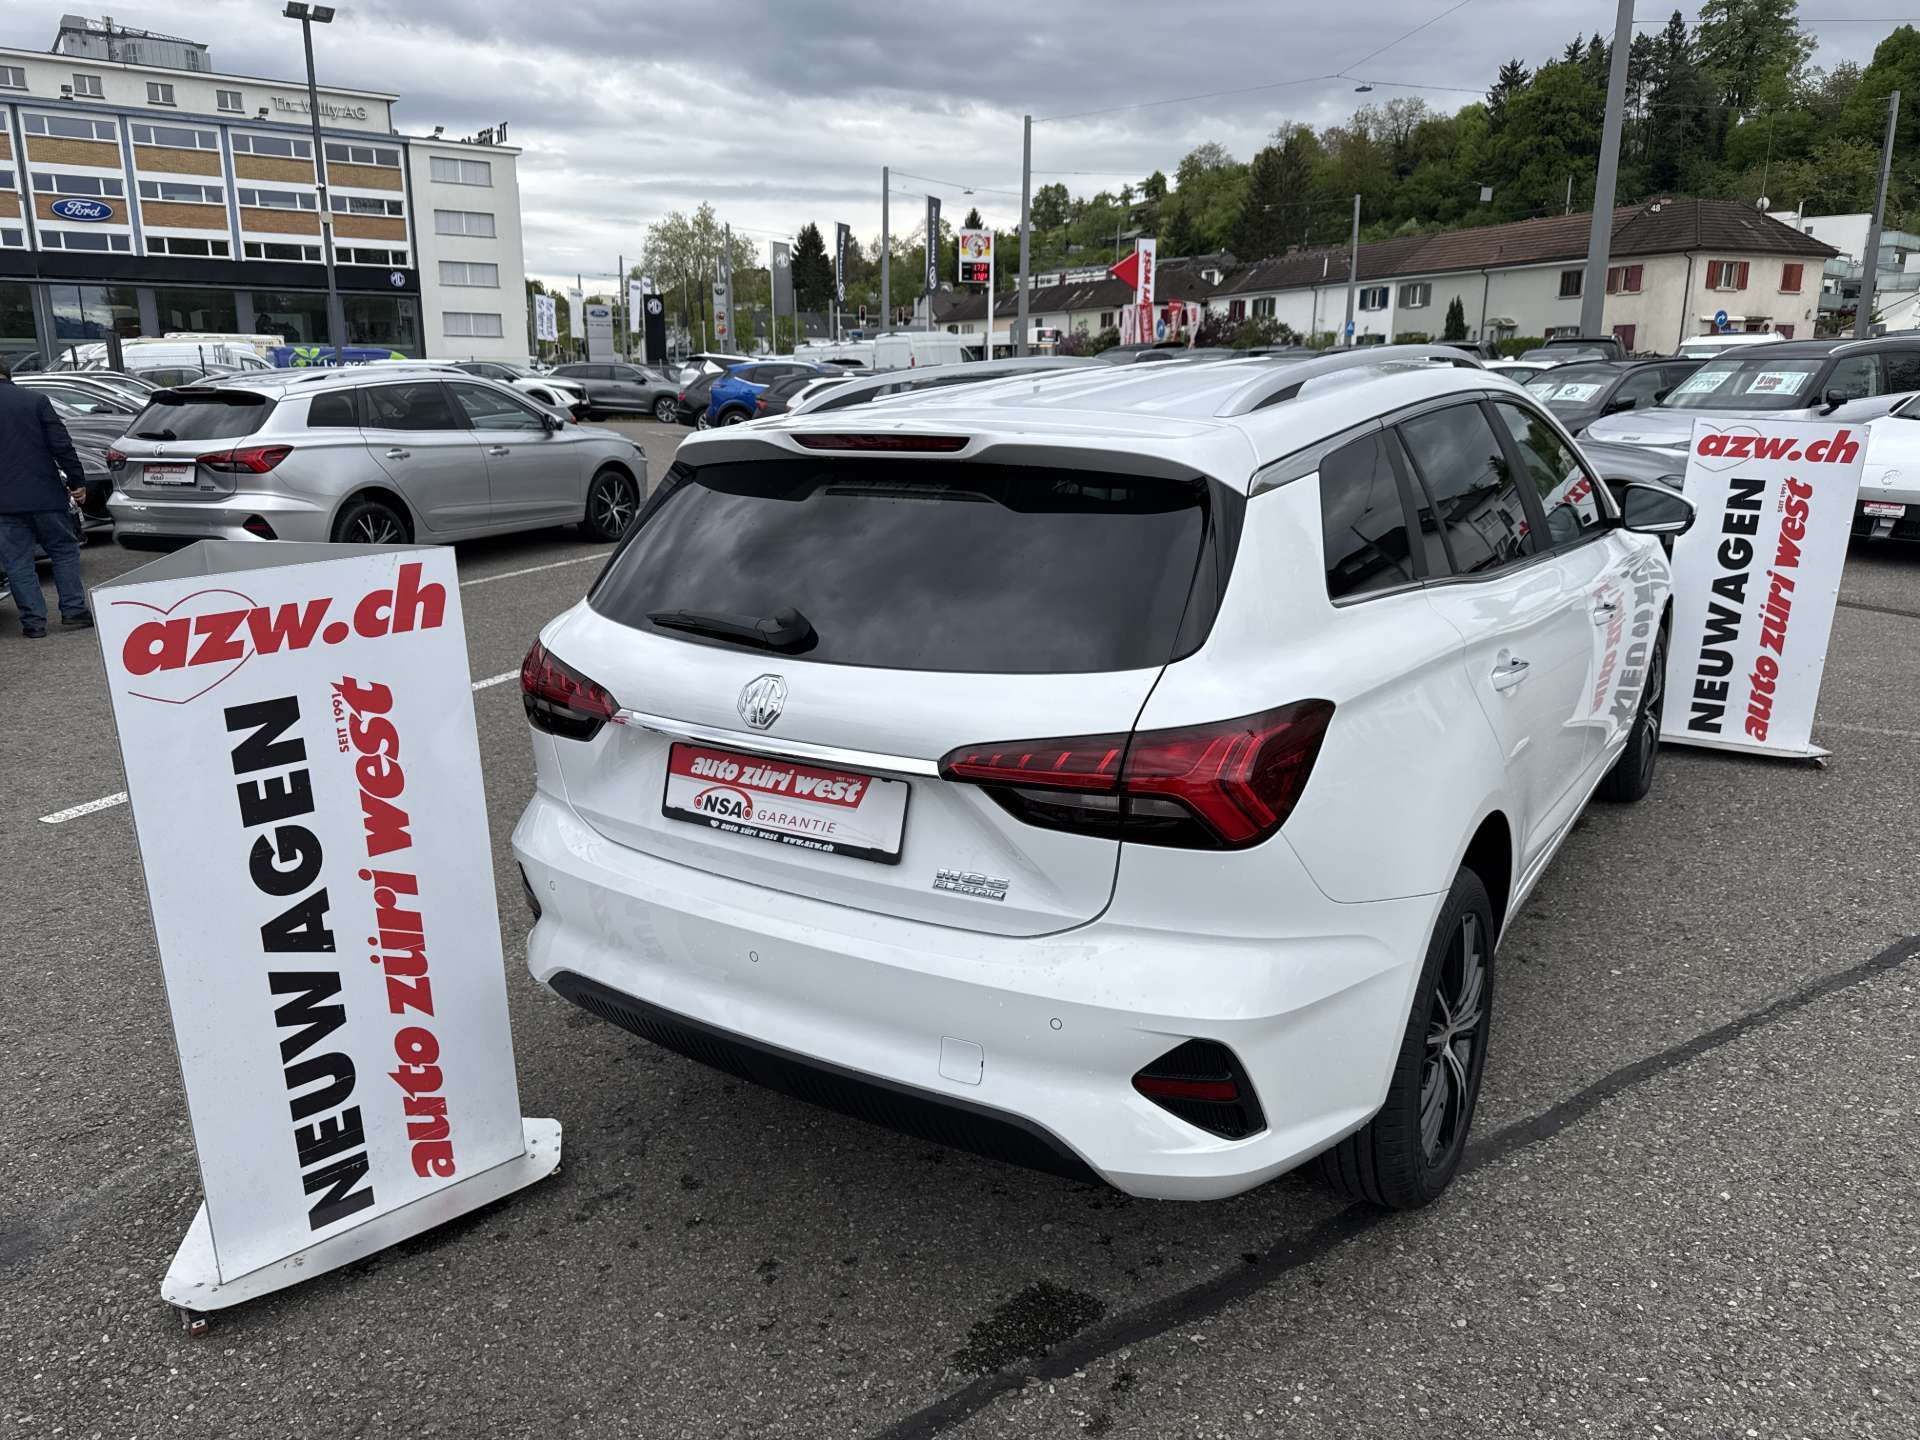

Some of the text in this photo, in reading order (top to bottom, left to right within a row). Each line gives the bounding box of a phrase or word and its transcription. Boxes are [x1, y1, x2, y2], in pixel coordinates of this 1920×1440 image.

[342, 104, 367, 120] AG
[64, 200, 101, 217] Ford
[1651, 203, 1661, 213] 48
[1697, 430, 1860, 464] azw.ch
[122, 562, 447, 675] azw.ch
[1687, 478, 1766, 734] NEUWAGEN
[1745, 476, 1813, 741] auto züri west
[334, 692, 350, 754] SEIT 1991
[737, 673, 788, 730] MG
[690, 756, 866, 803] auto züri west
[702, 794, 743, 819] NSA
[757, 809, 837, 834] GARANTIE
[720, 822, 834, 852] auto züri west www.azw.ch
[330, 675, 456, 1179] auto züri west
[223, 695, 376, 1232] NEUWAGEN
